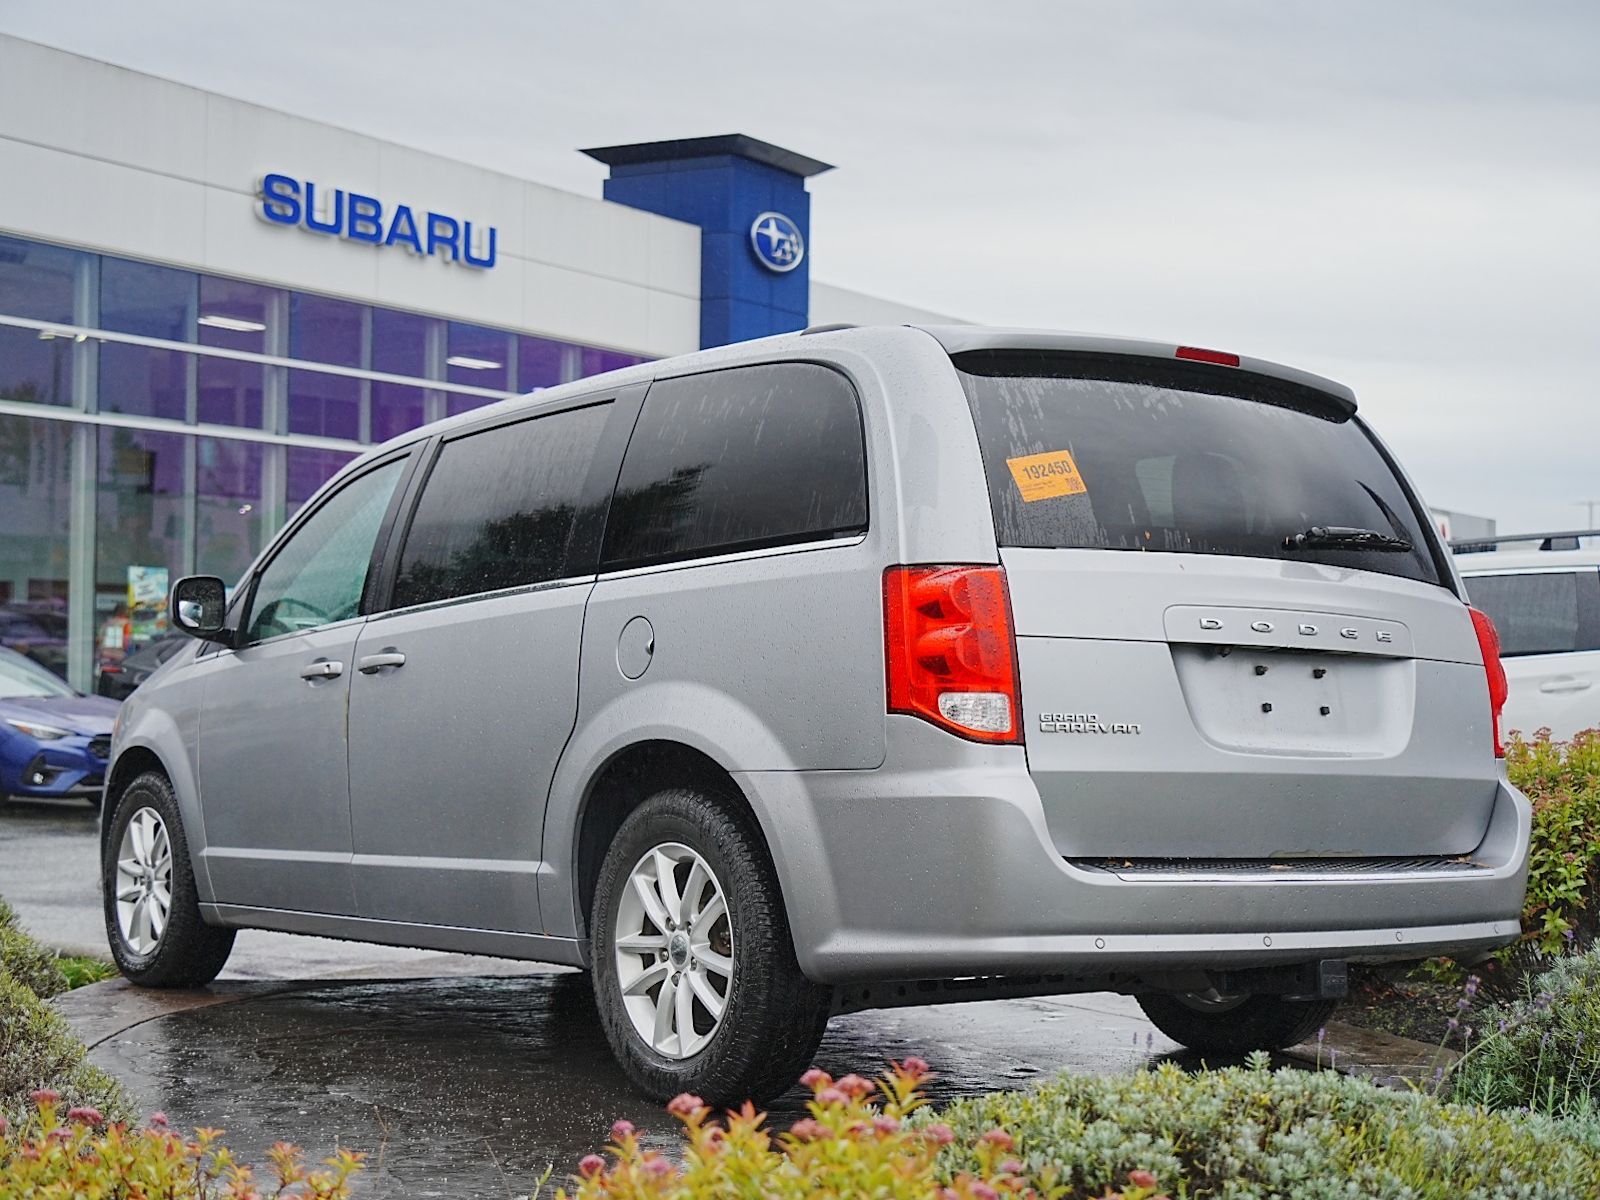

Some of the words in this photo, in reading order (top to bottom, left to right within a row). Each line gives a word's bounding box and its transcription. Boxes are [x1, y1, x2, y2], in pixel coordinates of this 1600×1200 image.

[262, 173, 497, 268] SUBARU
[1023, 460, 1072, 480] 192450
[1200, 617, 1392, 643] DODGE
[1039, 712, 1099, 723] GRAND
[1040, 722, 1141, 735] CARAVAN
